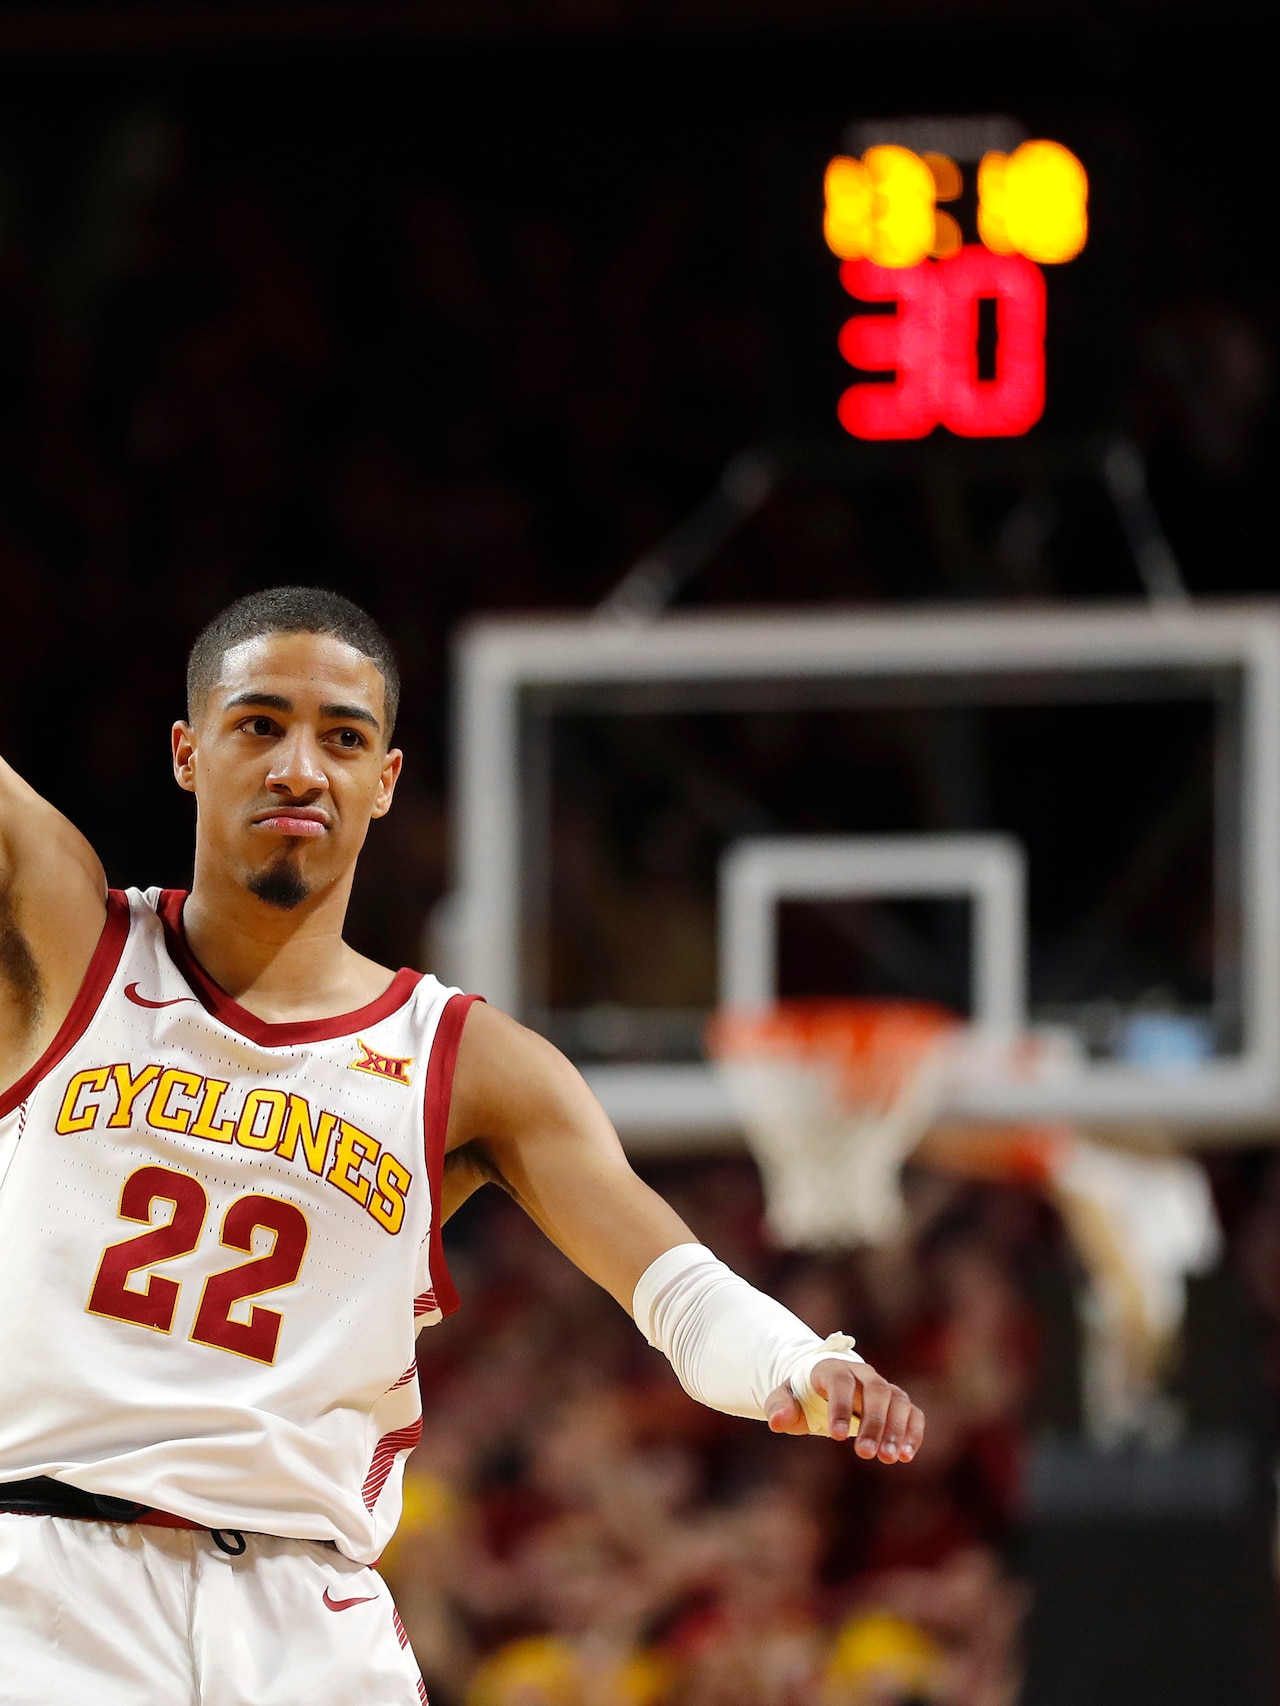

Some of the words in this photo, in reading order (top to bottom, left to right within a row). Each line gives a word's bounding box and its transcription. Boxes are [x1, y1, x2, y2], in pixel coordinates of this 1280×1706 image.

[837, 244, 1046, 441] 30
[55, 1063, 412, 1235] CYCLONES
[86, 1164, 311, 1366] 22
